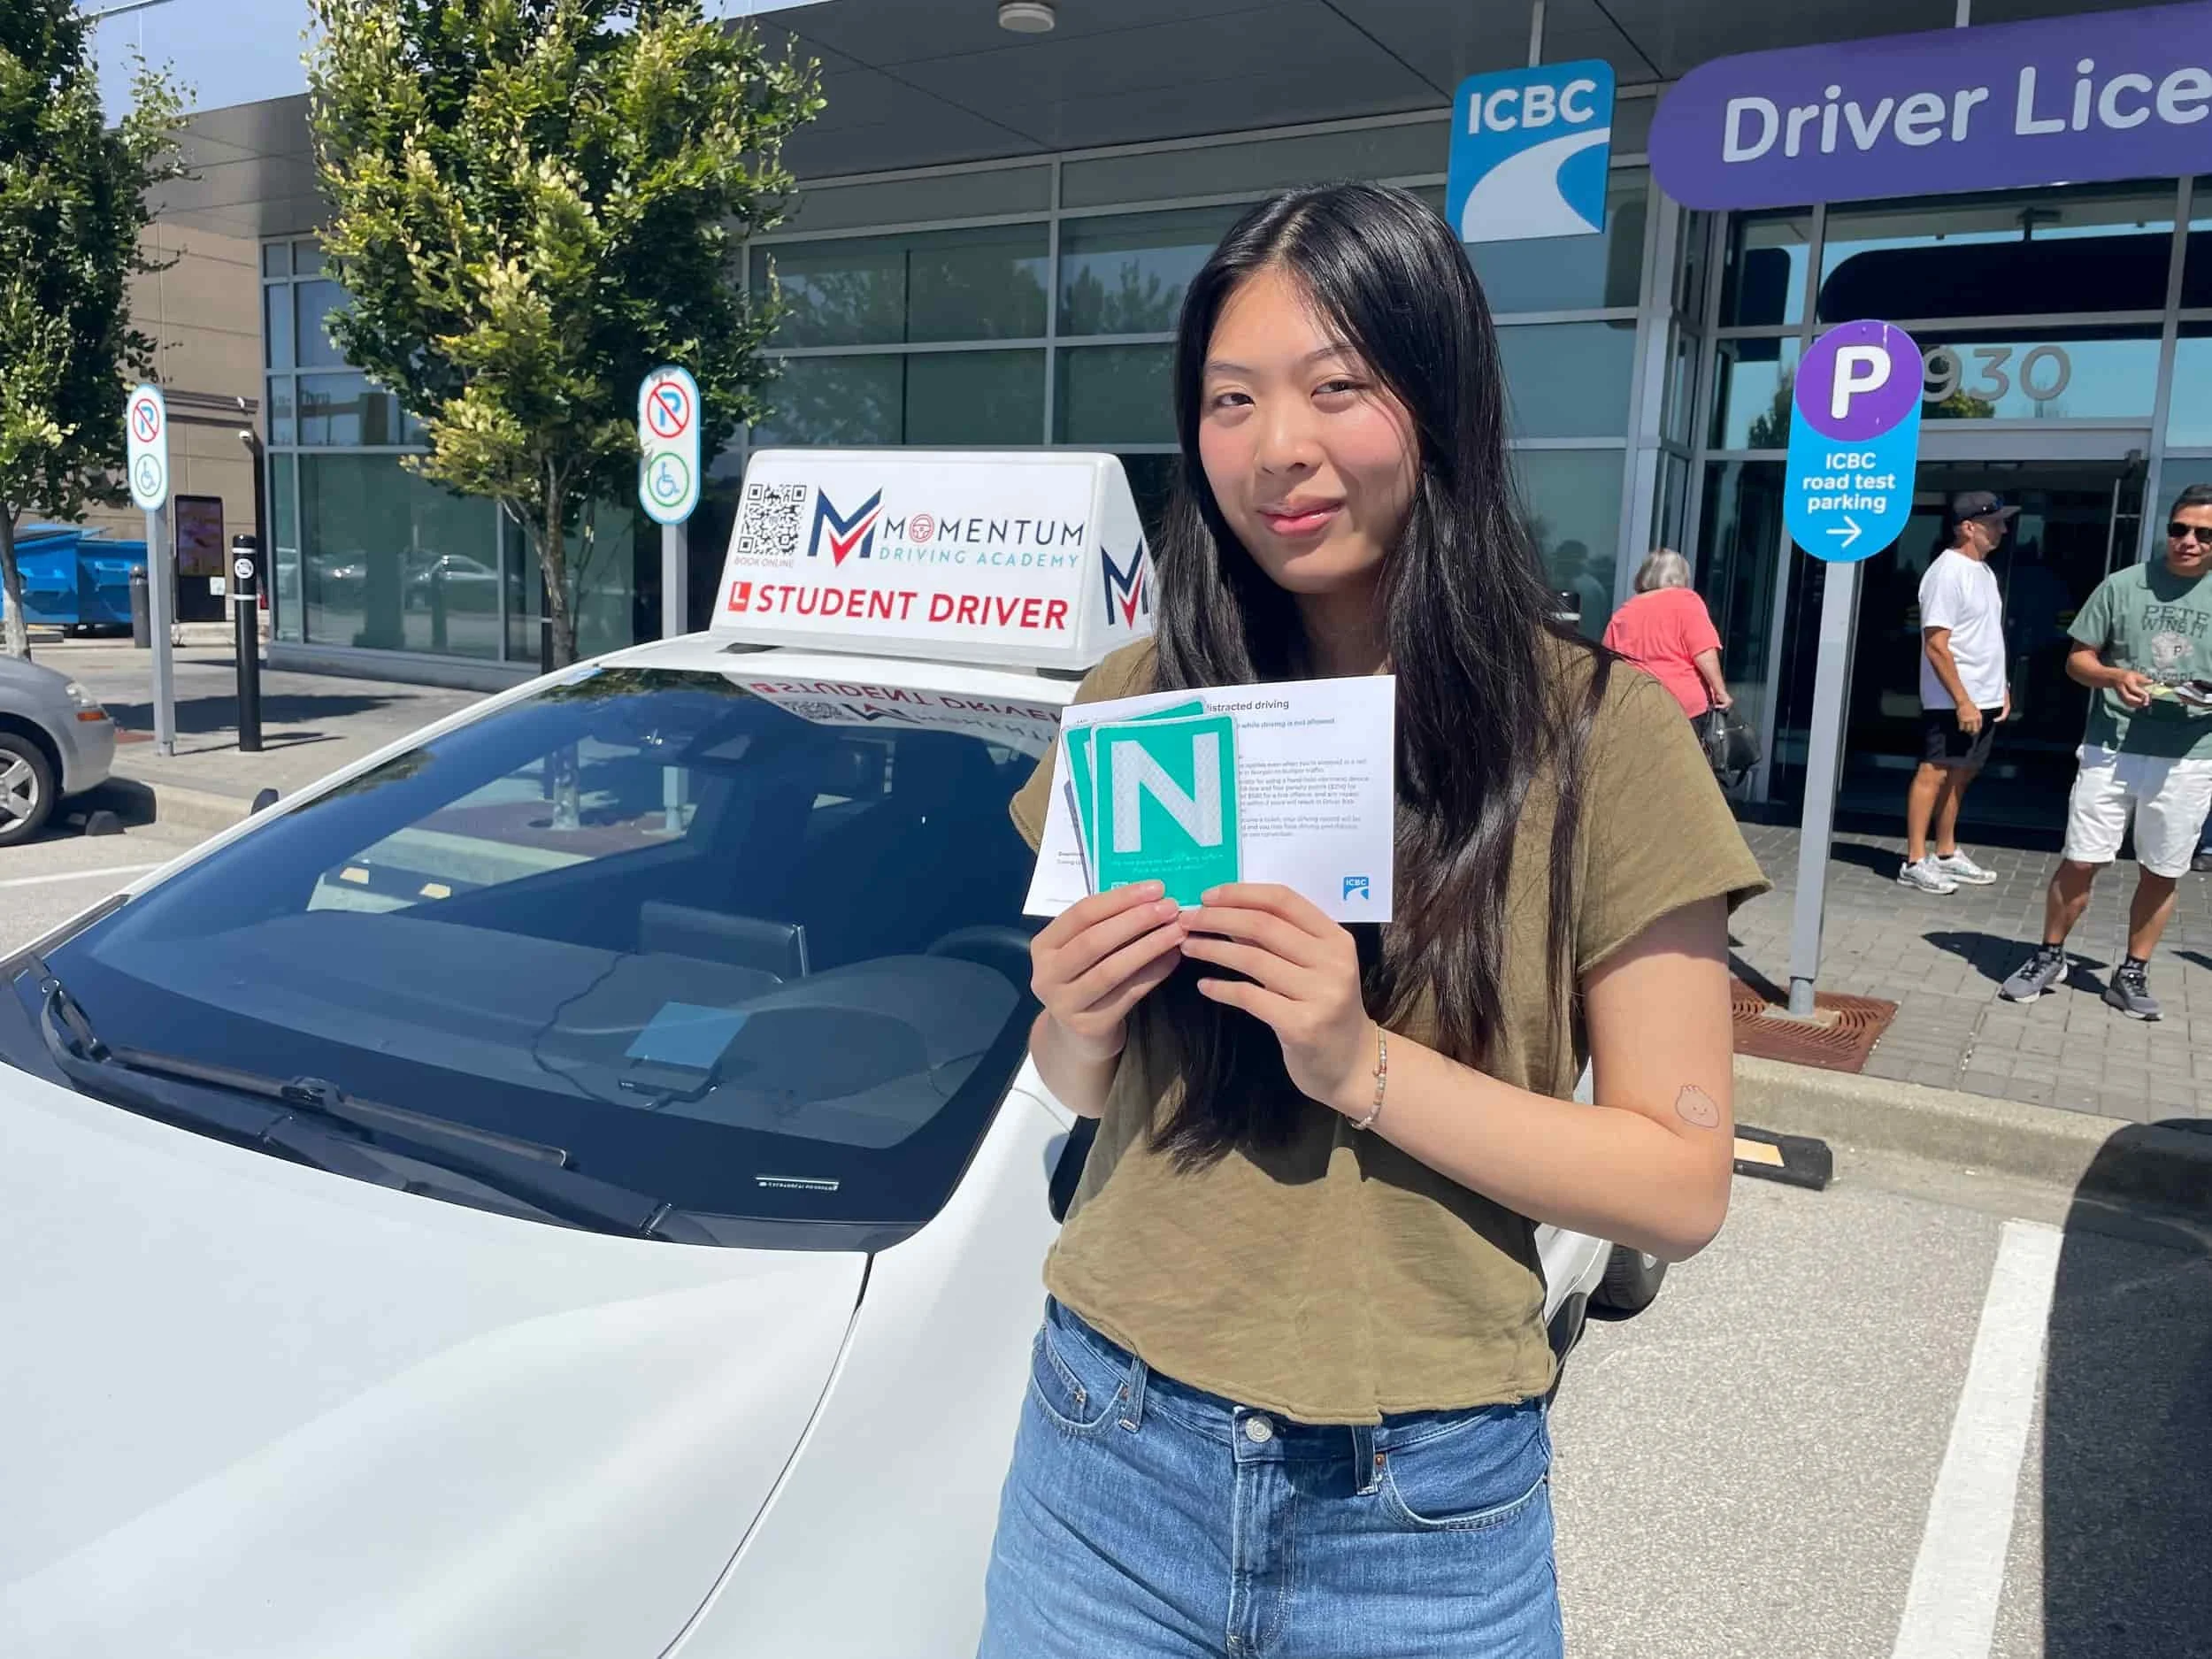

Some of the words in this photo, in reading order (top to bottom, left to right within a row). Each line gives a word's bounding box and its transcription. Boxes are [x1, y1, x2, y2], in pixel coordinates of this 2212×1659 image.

[1468, 79, 1598, 135] ICBC
[1722, 84, 1989, 163] Driver
[2015, 58, 2212, 135] Lice
[1831, 345, 1892, 420] P
[1825, 452, 1877, 470] ICBC
[1802, 472, 1848, 489] road
[1855, 473, 1896, 489] test
[1807, 493, 1887, 514] parking
[883, 513, 1086, 547] MOMENTUM
[733, 557, 759, 567] BOOK
[760, 557, 794, 569] ONLINE
[879, 547, 966, 565] DRIVING
[976, 551, 1079, 569] ACADEMY
[756, 584, 918, 620] STUDENT
[928, 593, 1070, 630] DRIVER
[1207, 701, 1253, 712] istracted
[1255, 699, 1289, 710] driving
[1110, 731, 1224, 853] N
[1346, 877, 1367, 886] ICBC
